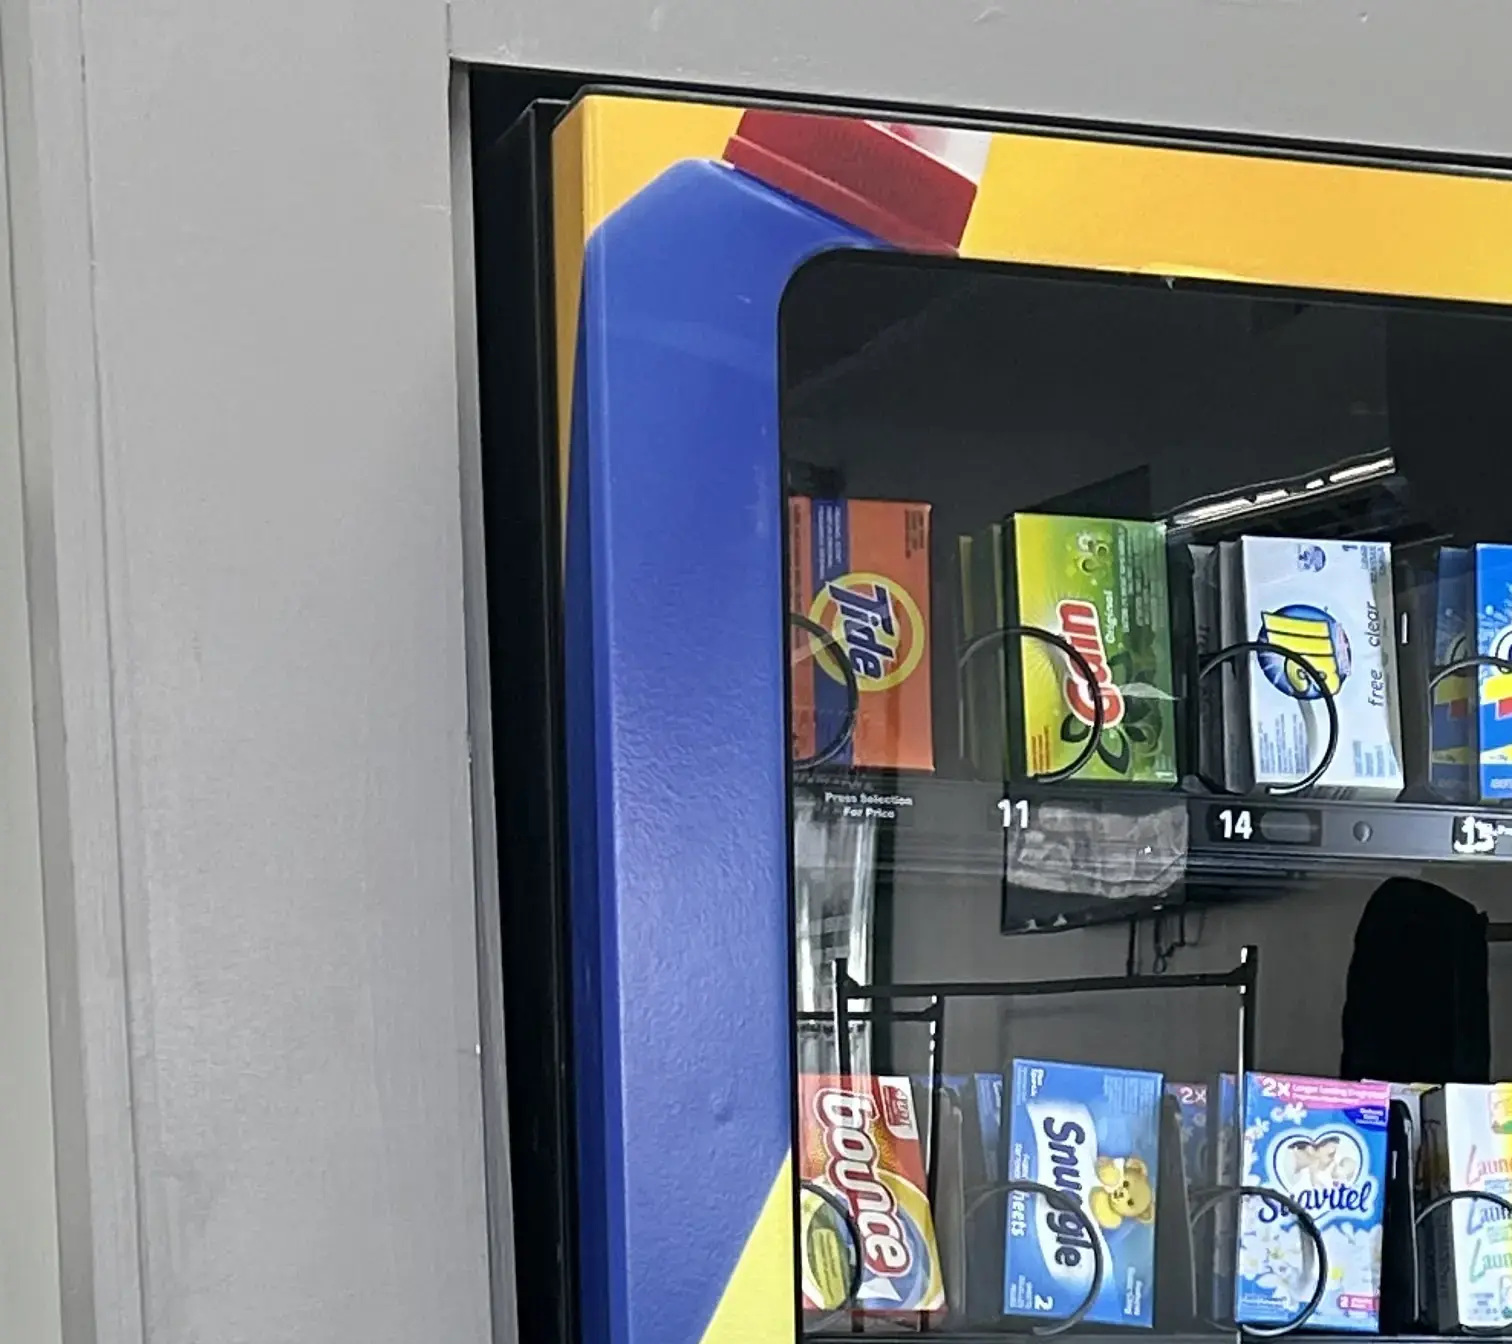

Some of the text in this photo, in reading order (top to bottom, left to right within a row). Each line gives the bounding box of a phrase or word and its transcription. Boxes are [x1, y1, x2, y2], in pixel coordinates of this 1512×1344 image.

[825, 581, 895, 680] Tide
[1103, 590, 1117, 643] Original
[1364, 601, 1381, 647] clear
[1057, 601, 1125, 727] Gain
[1368, 669, 1385, 707] free
[824, 792, 913, 805] Press Selection
[843, 806, 895, 819] For Price
[997, 800, 1030, 829] 11
[1219, 810, 1254, 840] 14
[1011, 1184, 1030, 1237] heets
[1034, 1295, 1053, 1311] 2
